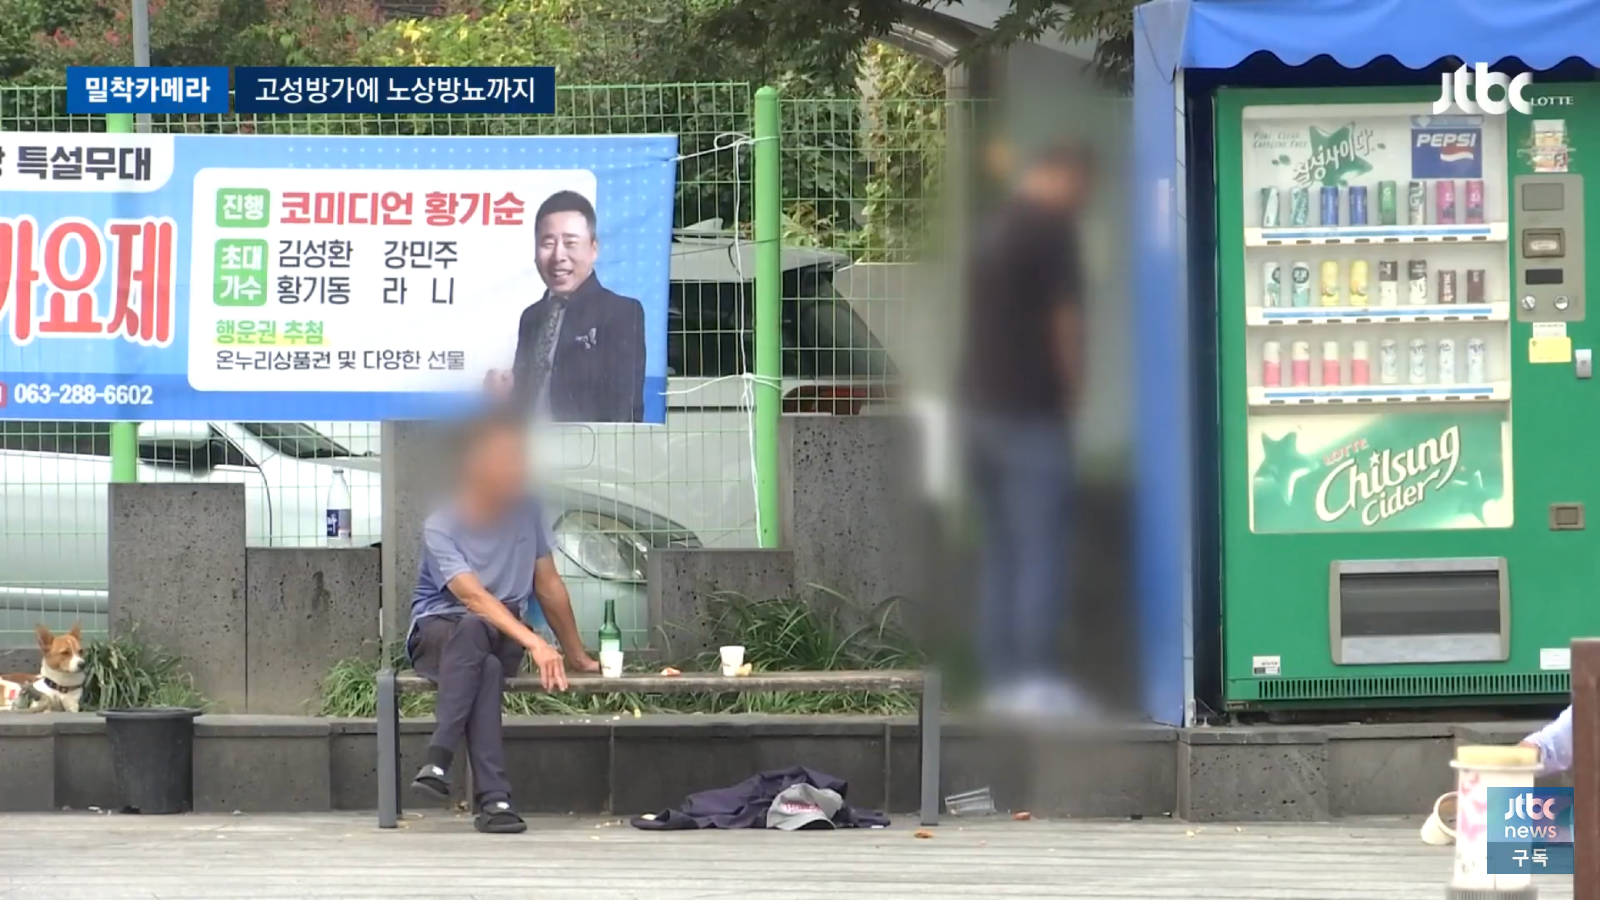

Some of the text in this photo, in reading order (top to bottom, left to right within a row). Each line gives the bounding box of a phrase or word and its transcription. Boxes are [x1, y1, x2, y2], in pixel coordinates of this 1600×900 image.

[1531, 96, 1574, 106] LOTTE
[1416, 132, 1477, 148] PEPSI
[17, 146, 152, 181] 특설무대
[222, 193, 265, 221] 진행
[280, 191, 526, 227] 코미디언 황기순
[220, 244, 263, 271] 초대
[278, 239, 459, 270] 김성환 강민주
[219, 274, 263, 301] 가수
[276, 274, 352, 306] 황기동
[215, 319, 325, 345] 행운권 추첨
[215, 349, 466, 371] 온누리상품권 및 다양한 선물
[14, 384, 154, 405] 063-288-6602
[1323, 438, 1370, 466] LOTTE
[1315, 425, 1461, 523] Chilsung
[1361, 468, 1442, 527] Cider
